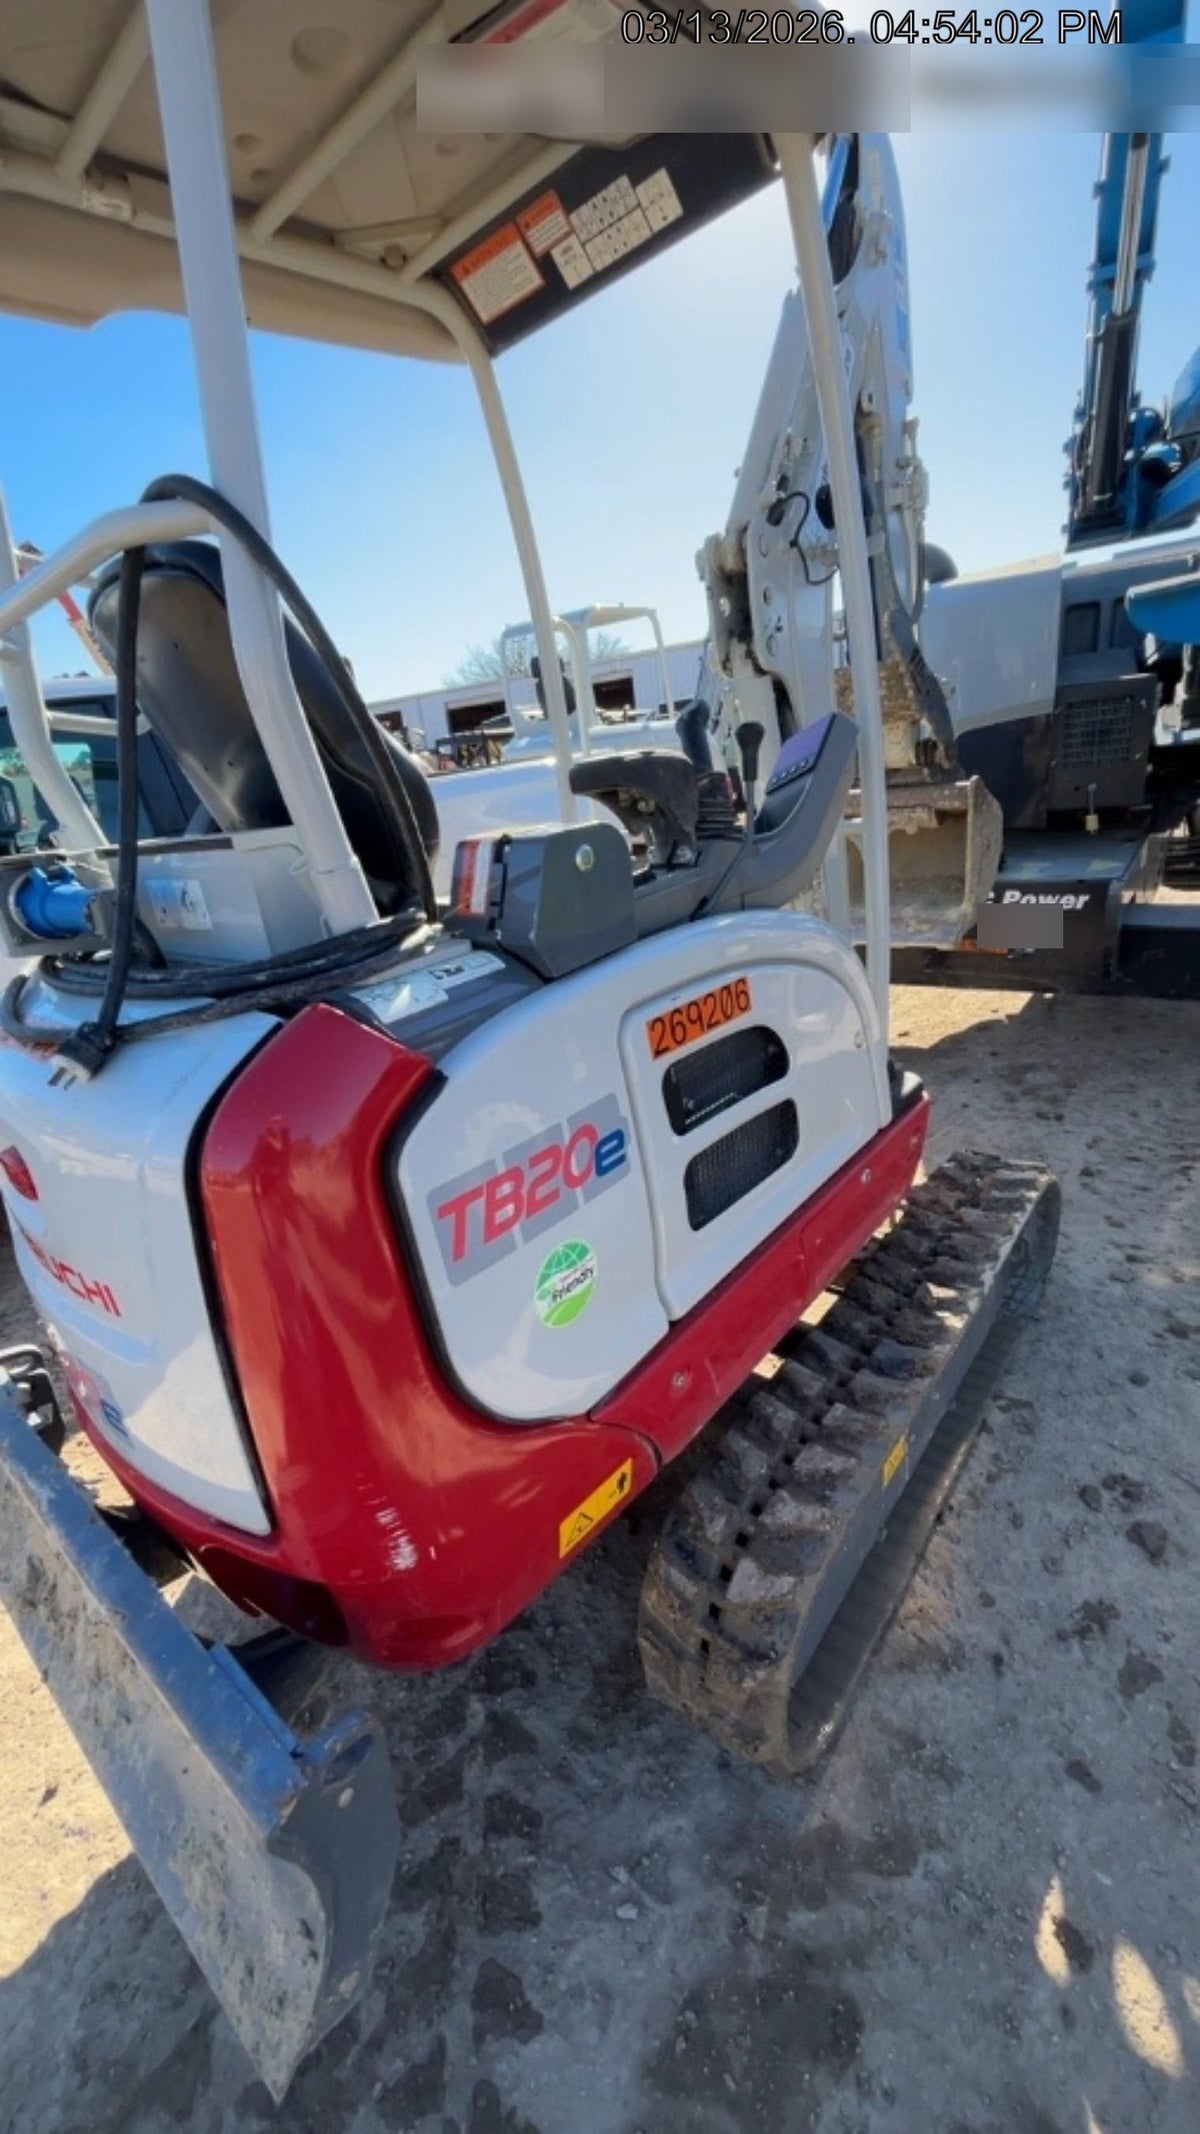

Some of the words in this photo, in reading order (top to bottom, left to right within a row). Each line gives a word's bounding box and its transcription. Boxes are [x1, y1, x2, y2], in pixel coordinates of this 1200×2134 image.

[650, 978, 751, 1058] 269206
[437, 1123, 627, 1264] TB20e
[551, 1266, 595, 1302] Friendly
